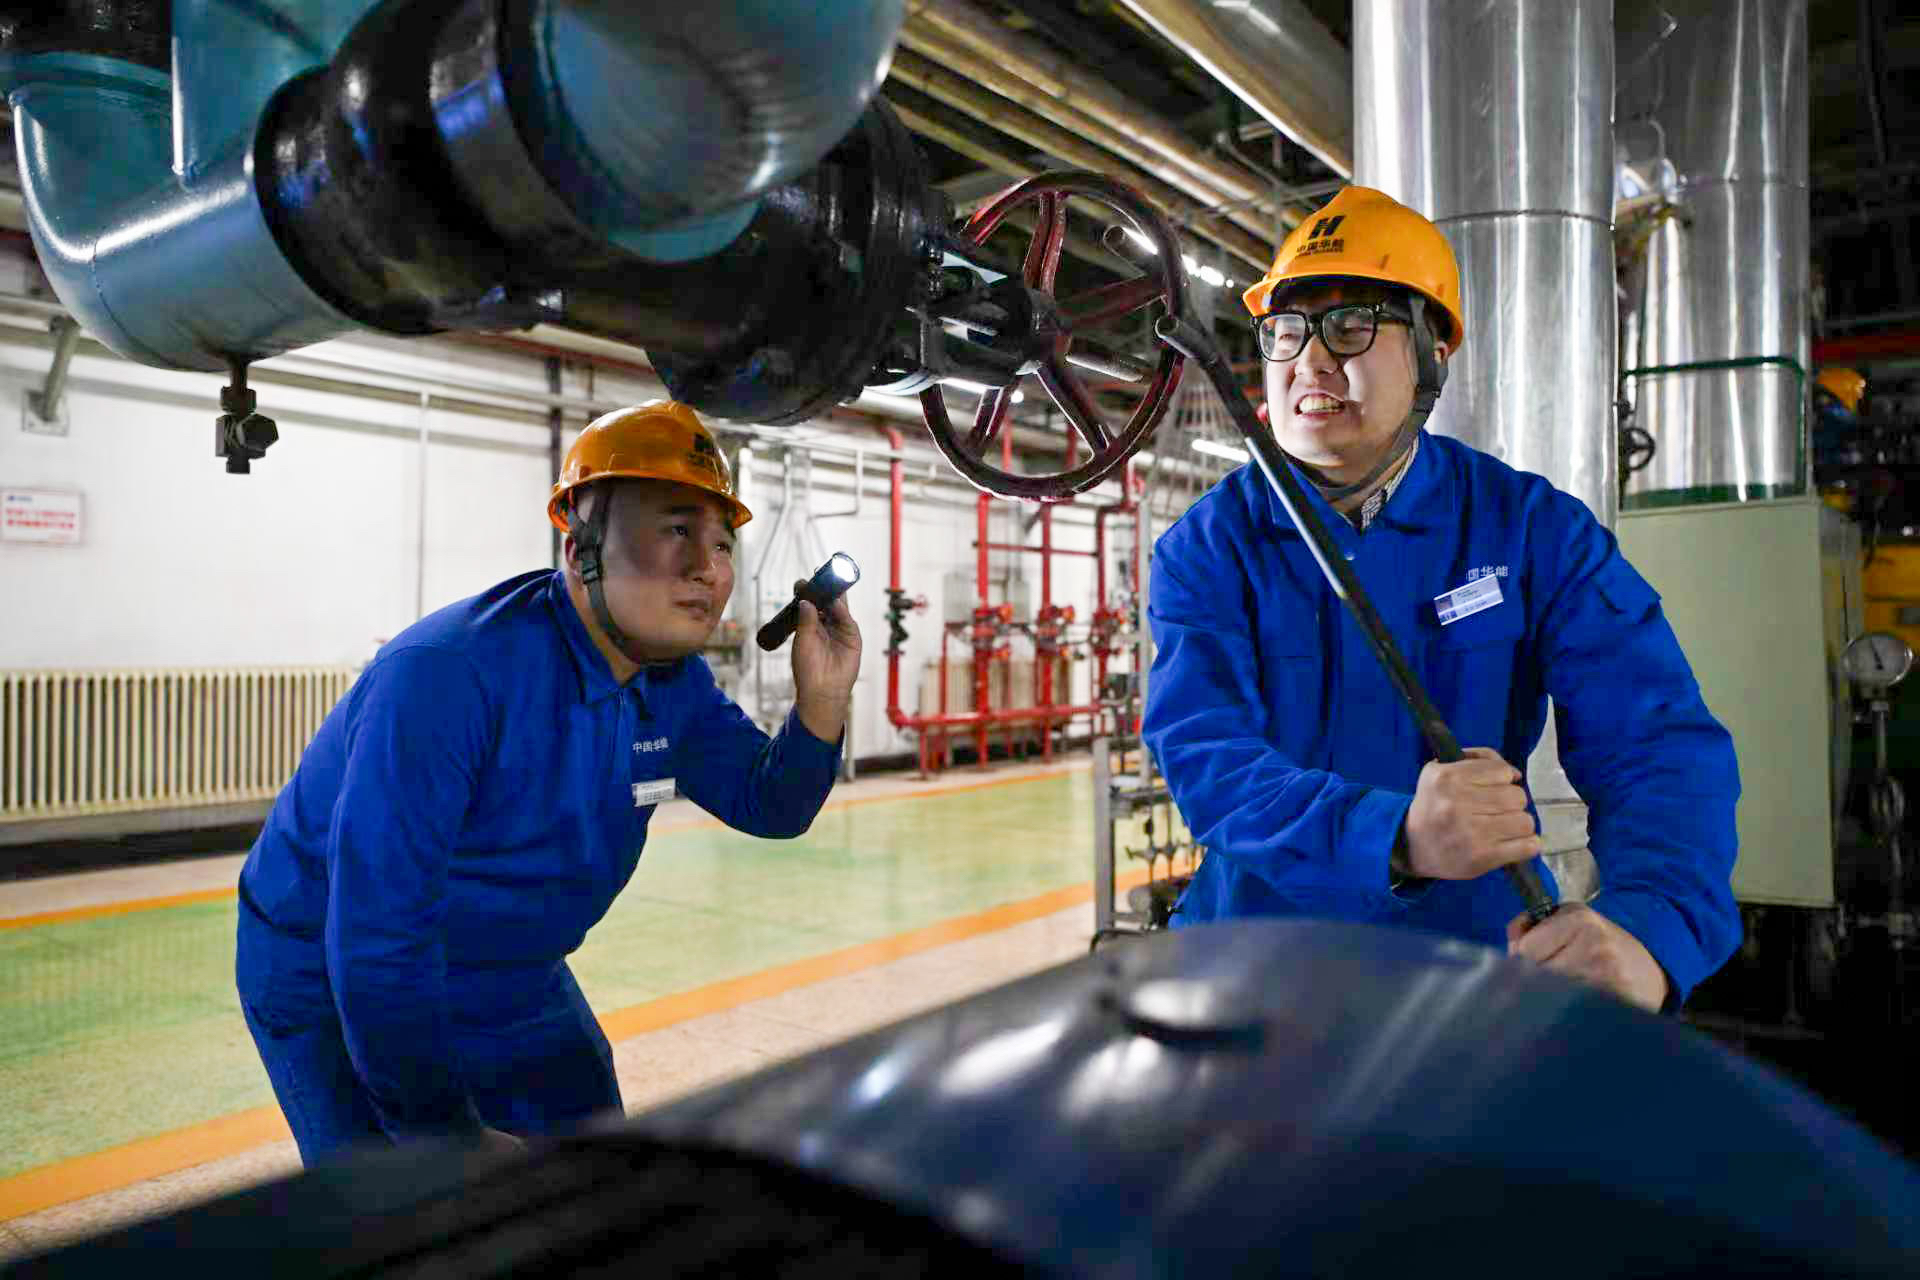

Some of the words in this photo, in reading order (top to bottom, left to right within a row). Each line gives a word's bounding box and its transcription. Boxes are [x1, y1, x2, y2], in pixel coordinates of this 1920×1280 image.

[1297, 239, 1344, 253] 中国华能
[1466, 565, 1509, 581] 国华能
[632, 736, 669, 753] 中国华能
